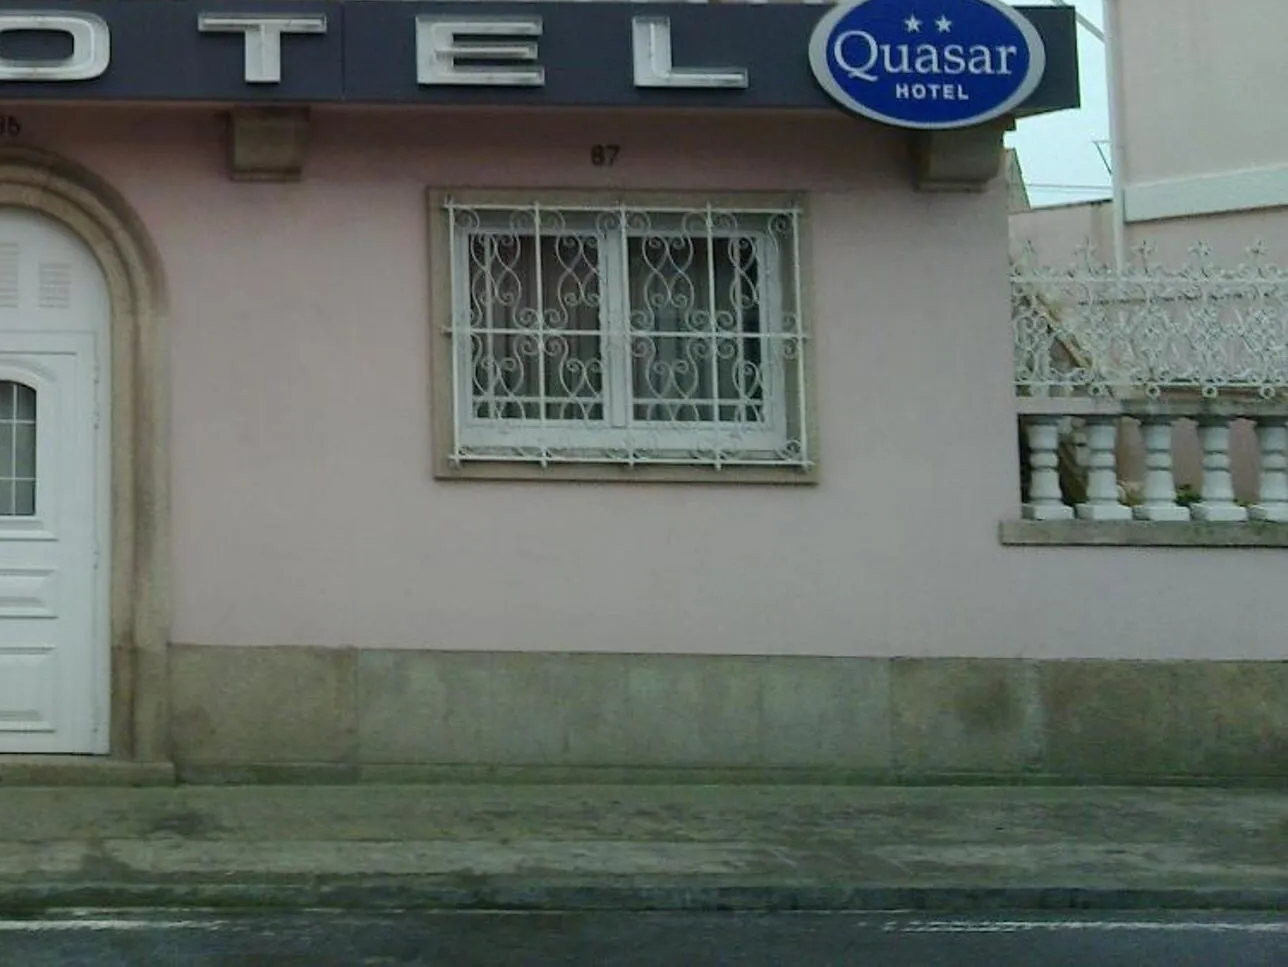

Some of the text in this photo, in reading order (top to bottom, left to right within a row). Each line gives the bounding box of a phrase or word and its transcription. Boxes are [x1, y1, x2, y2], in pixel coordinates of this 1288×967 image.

[834, 30, 1016, 81] Quasar
[895, 83, 969, 100] HOTEL
[591, 144, 621, 167] 87
